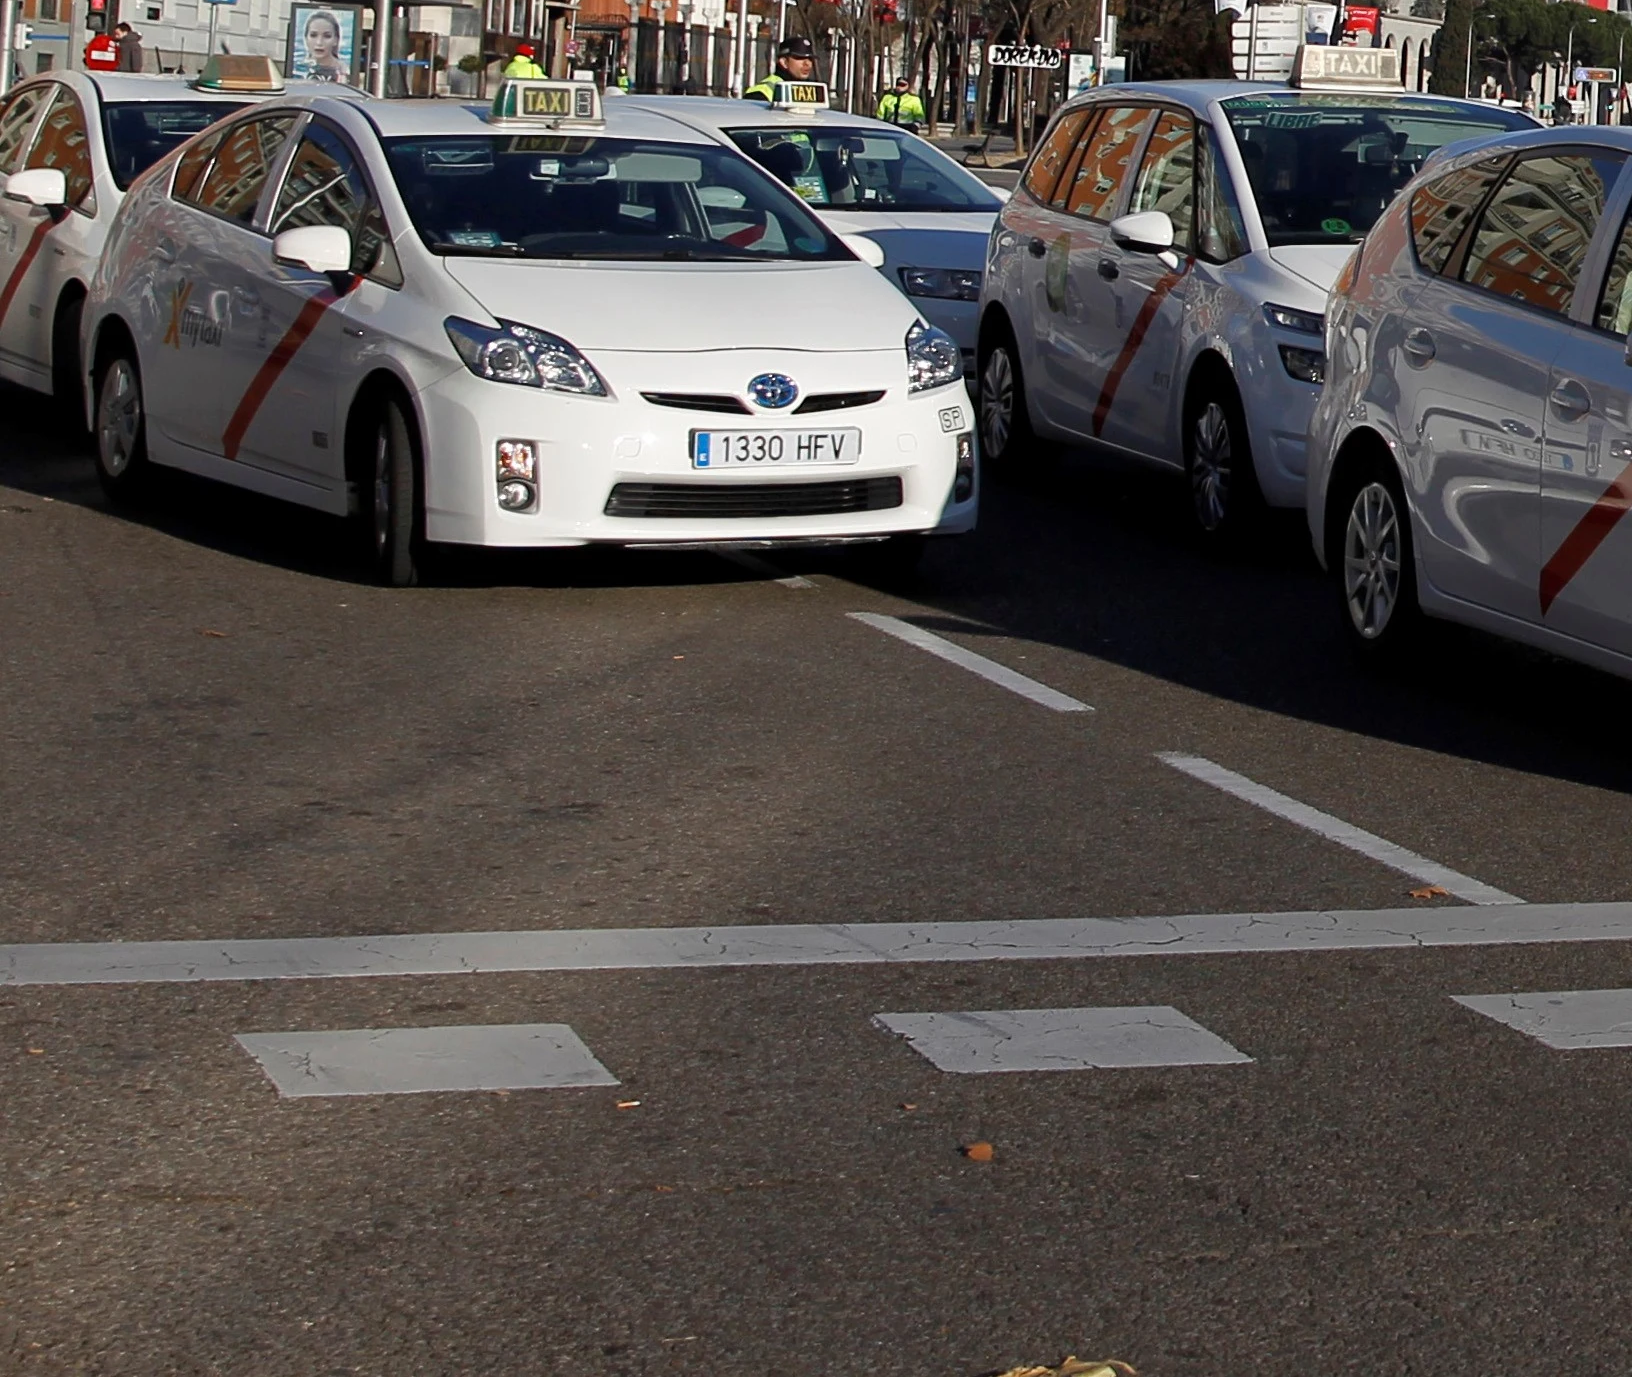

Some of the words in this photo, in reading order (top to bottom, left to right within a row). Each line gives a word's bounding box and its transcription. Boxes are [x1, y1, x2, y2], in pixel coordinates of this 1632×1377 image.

[1326, 53, 1376, 74] TAXI
[525, 91, 569, 112] TAXI
[792, 86, 816, 101] TAXI
[1269, 113, 1323, 127] LIBRE
[942, 410, 960, 429] SP
[722, 434, 783, 462] 1330
[797, 434, 845, 460] HFV
